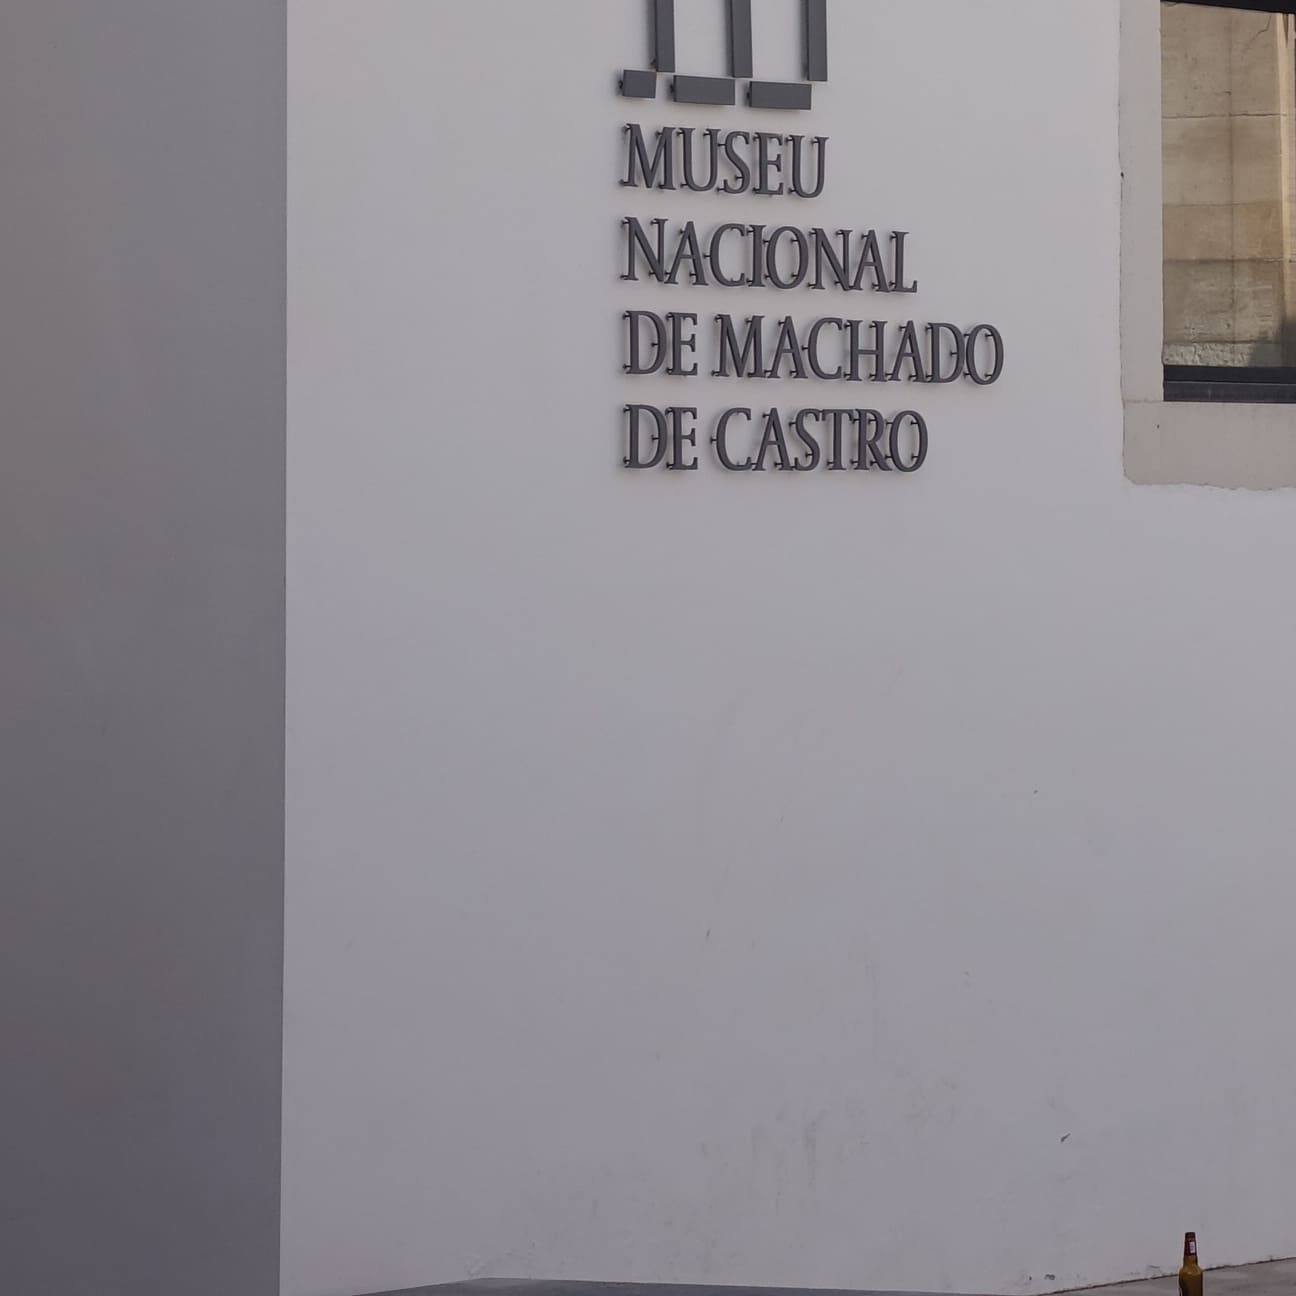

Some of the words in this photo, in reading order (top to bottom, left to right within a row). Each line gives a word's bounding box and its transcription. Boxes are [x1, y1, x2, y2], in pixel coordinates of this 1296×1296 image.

[619, 122, 829, 198] MUSEU
[620, 216, 918, 293] NACIONAL
[621, 310, 698, 376] DE
[711, 313, 1004, 385] MACHADO
[621, 403, 699, 470] DE
[710, 407, 929, 472] CASTRO
